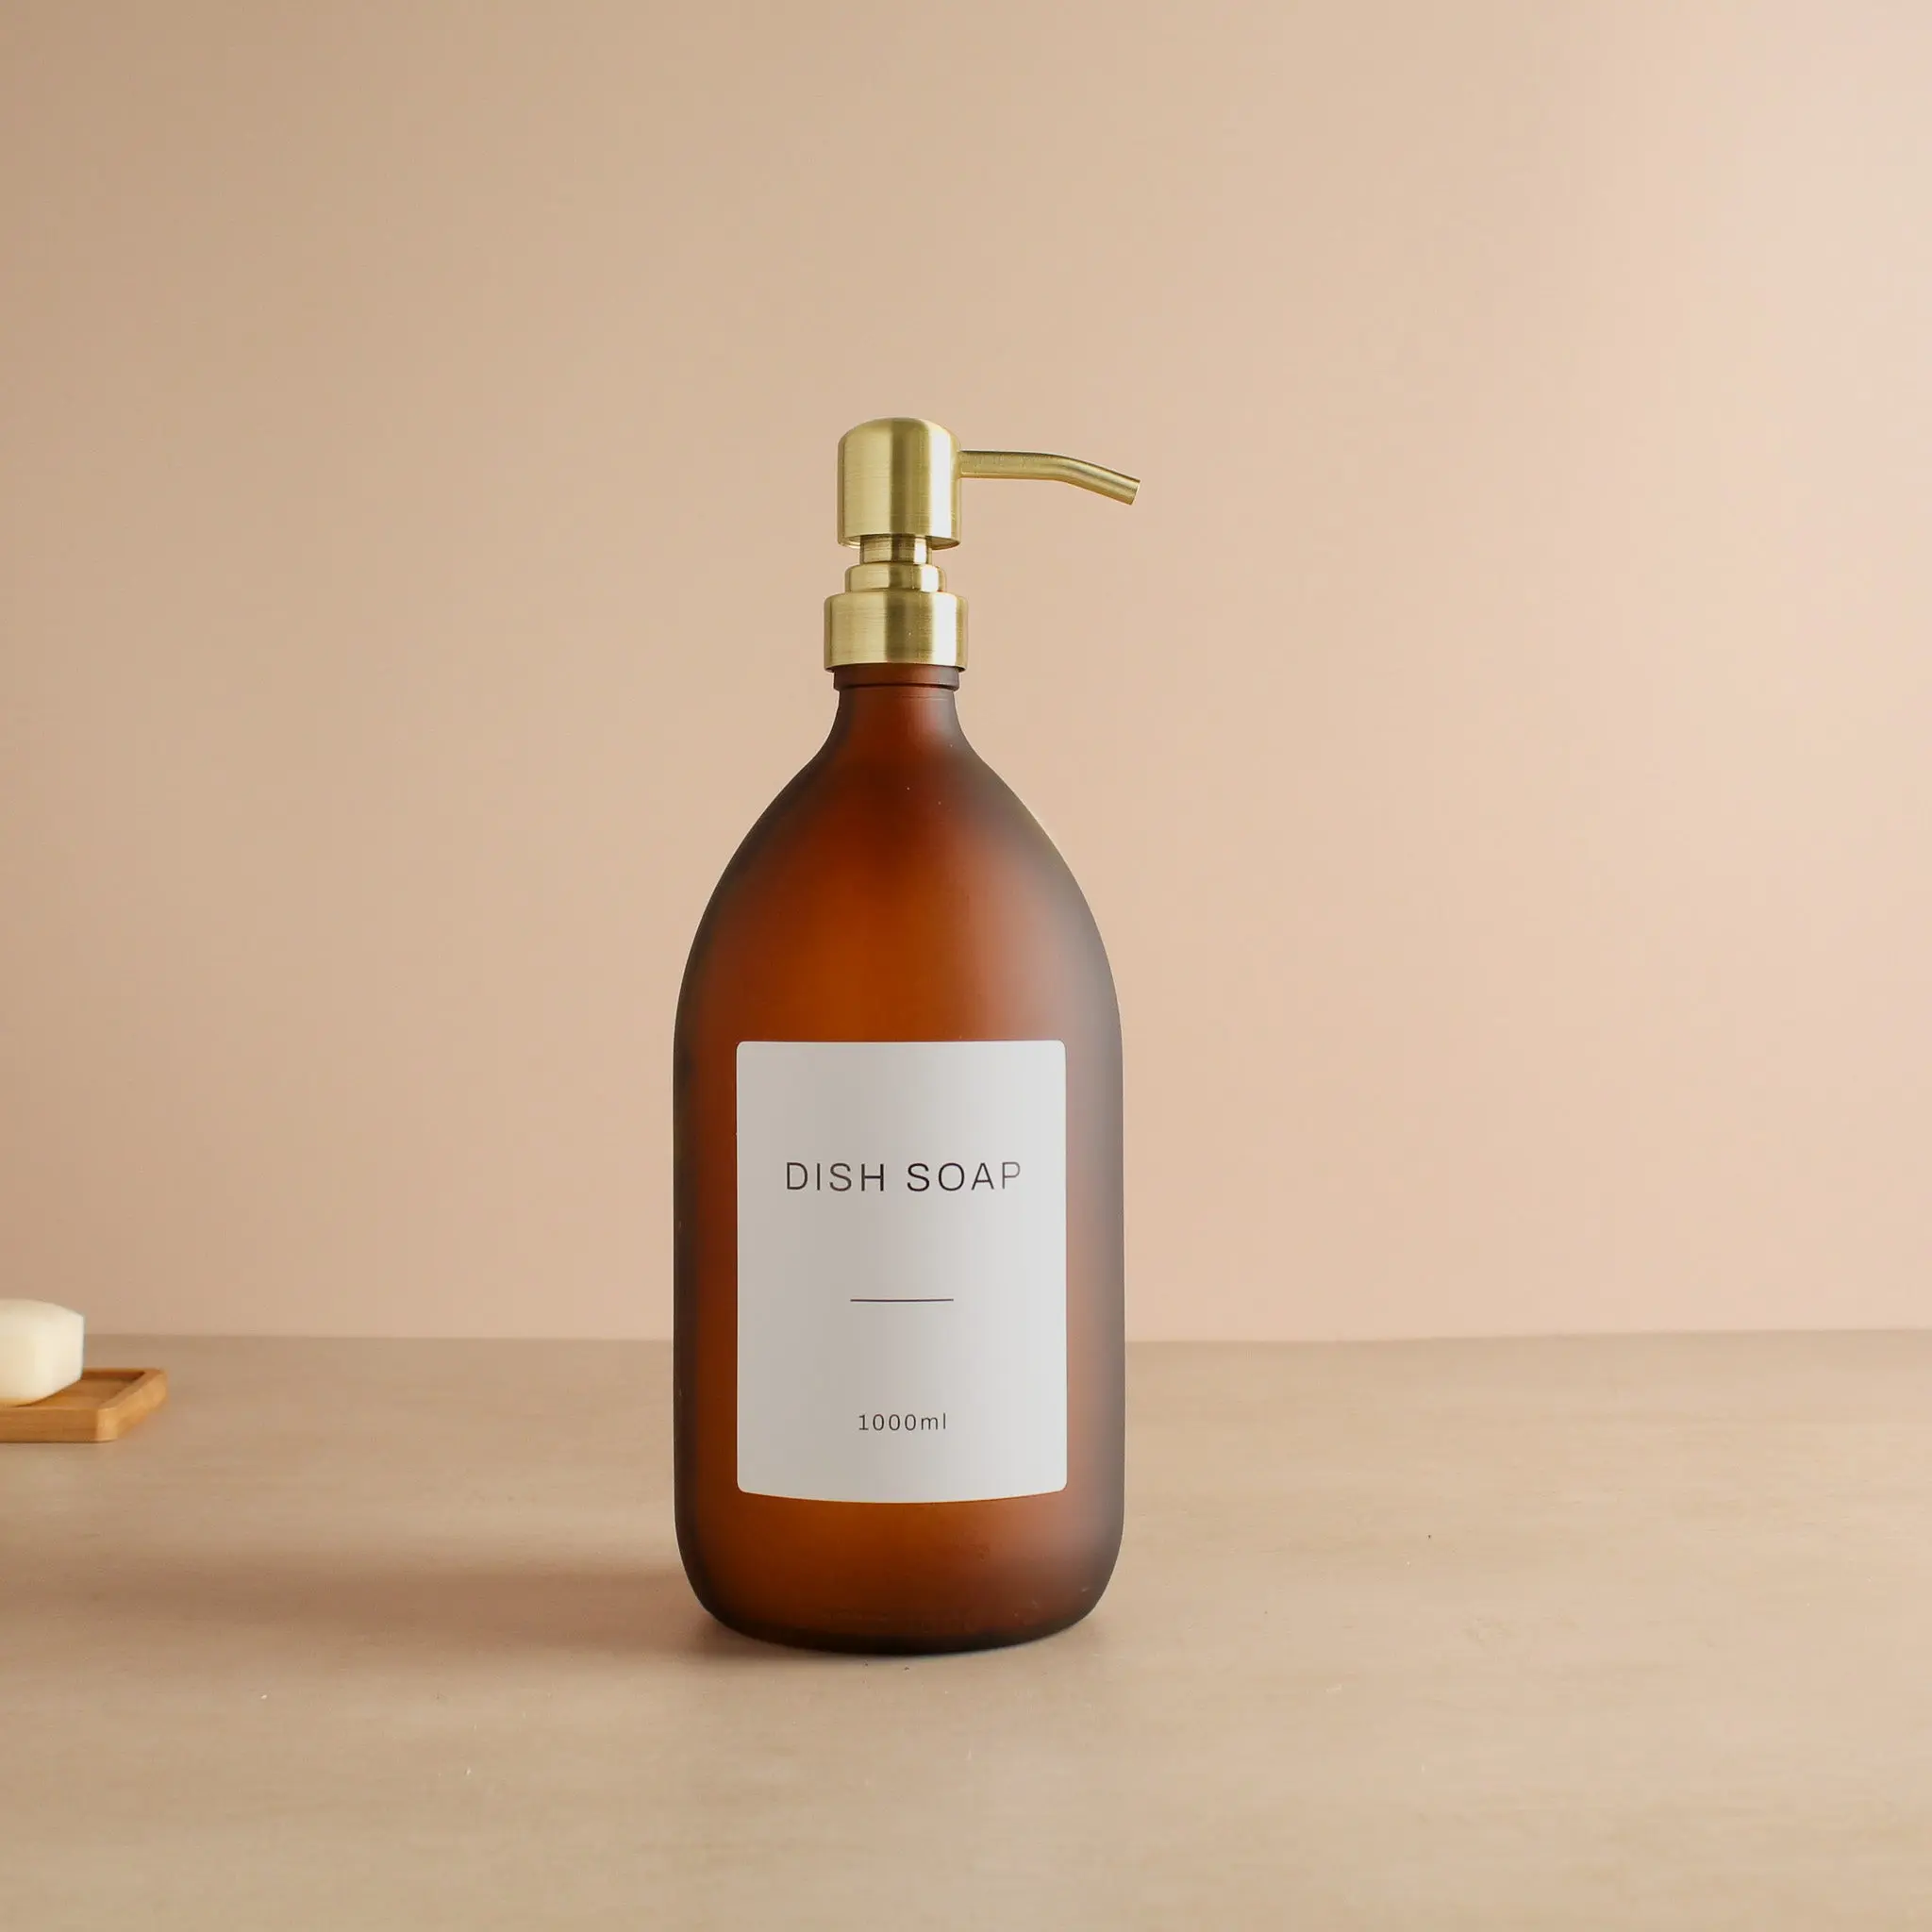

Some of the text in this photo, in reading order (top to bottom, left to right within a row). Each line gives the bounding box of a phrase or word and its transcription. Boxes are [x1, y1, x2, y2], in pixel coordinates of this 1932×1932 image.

[786, 1161, 1022, 1192] DISH SOAP
[858, 1412, 947, 1432] 1000ml
